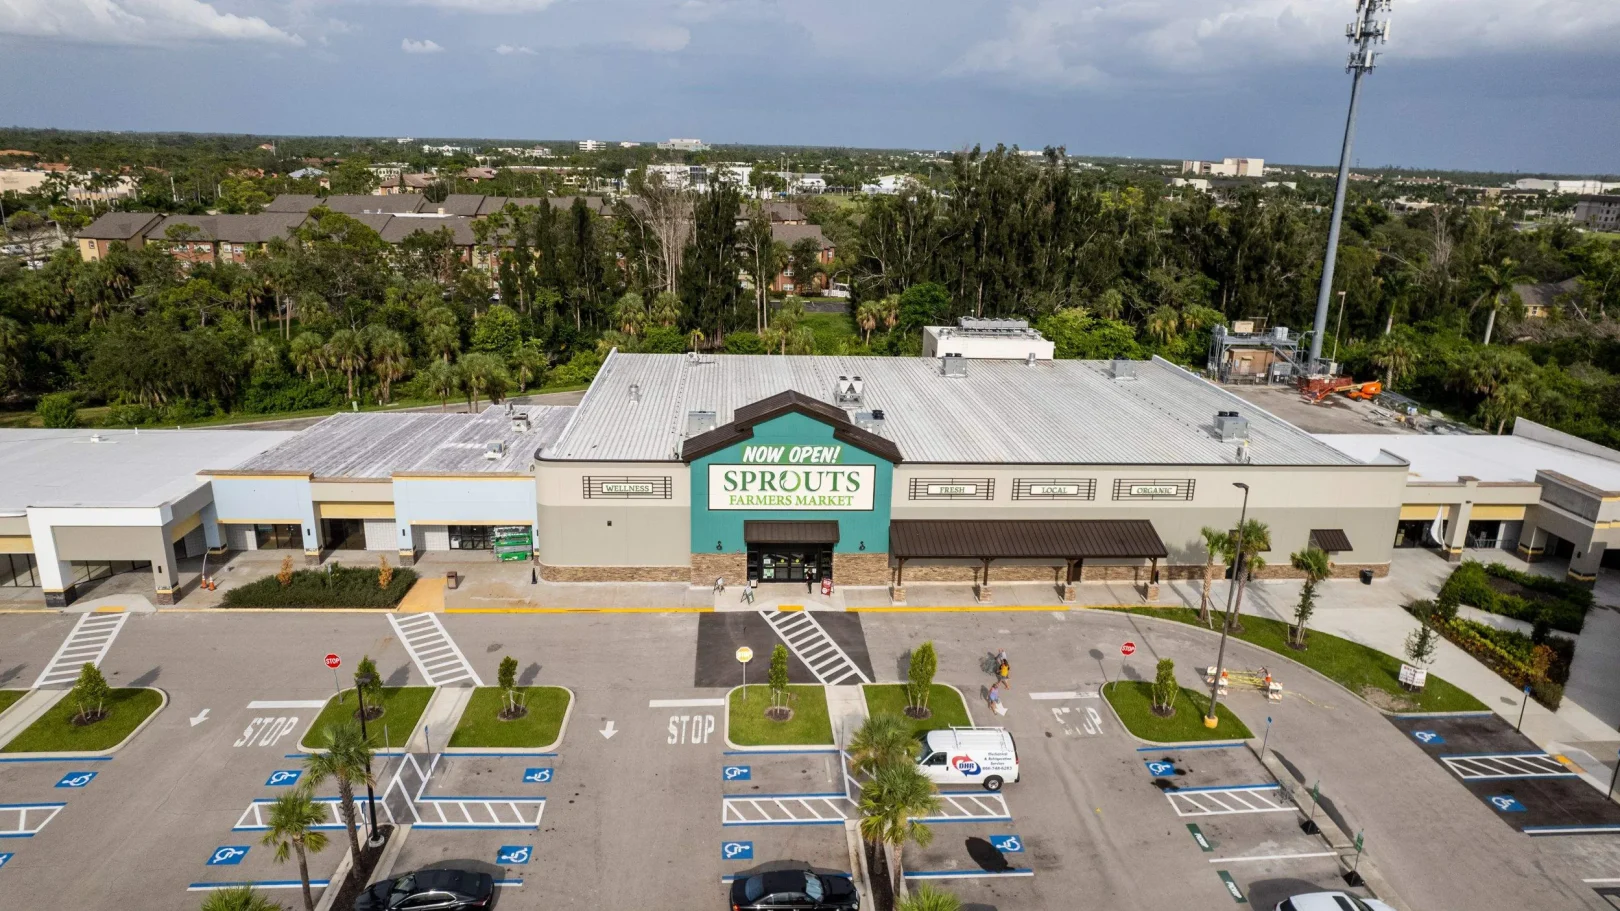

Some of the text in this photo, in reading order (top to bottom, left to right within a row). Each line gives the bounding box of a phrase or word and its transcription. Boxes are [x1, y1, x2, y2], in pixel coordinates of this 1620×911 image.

[742, 445, 841, 463] NOW OPEN!
[605, 484, 650, 492] WELLNESS
[723, 470, 861, 493] SPROUTS
[1041, 486, 1068, 494] LOCAL
[729, 494, 854, 506] FARMERS MARKET
[233, 717, 299, 747] STOP
[667, 714, 715, 744] STOP
